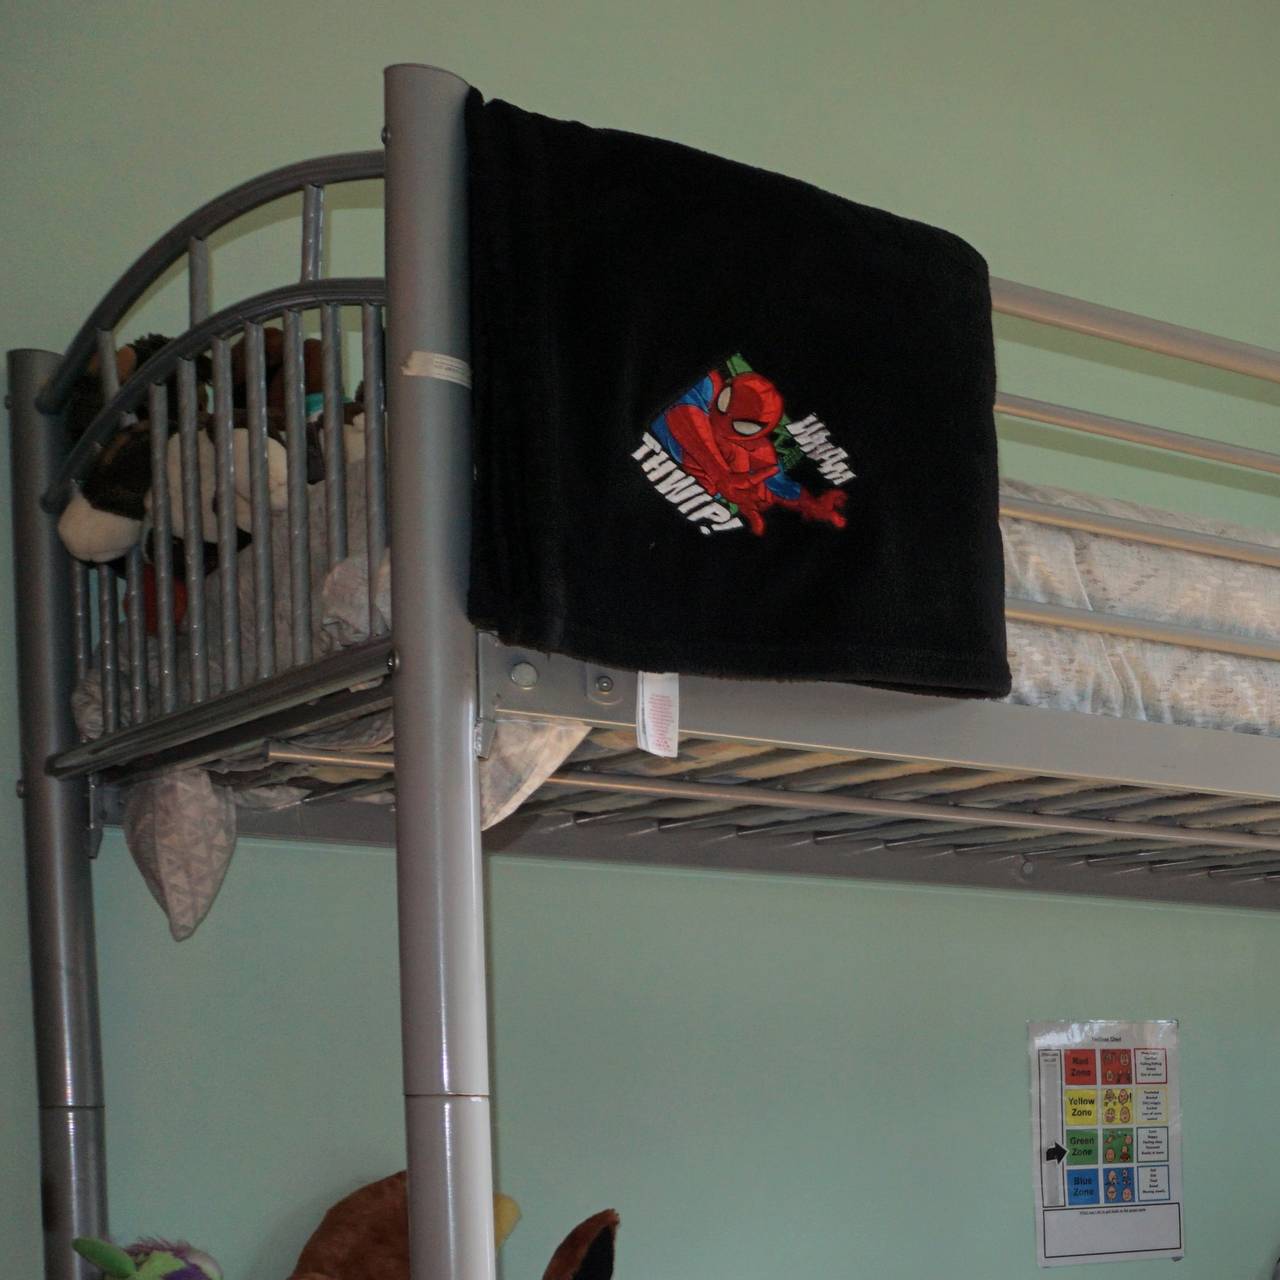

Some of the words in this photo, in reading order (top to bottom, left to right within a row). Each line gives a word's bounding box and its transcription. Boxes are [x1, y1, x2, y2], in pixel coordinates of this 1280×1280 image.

[631, 432, 743, 535] THWIP!
[1068, 1097, 1095, 1106] Yellow
[1071, 1108, 1092, 1117] Zone
[1070, 1137, 1094, 1145] Green
[1072, 1148, 1092, 1156] Zone
[1073, 1177, 1092, 1185] Blue
[1073, 1188, 1094, 1197] Zone
